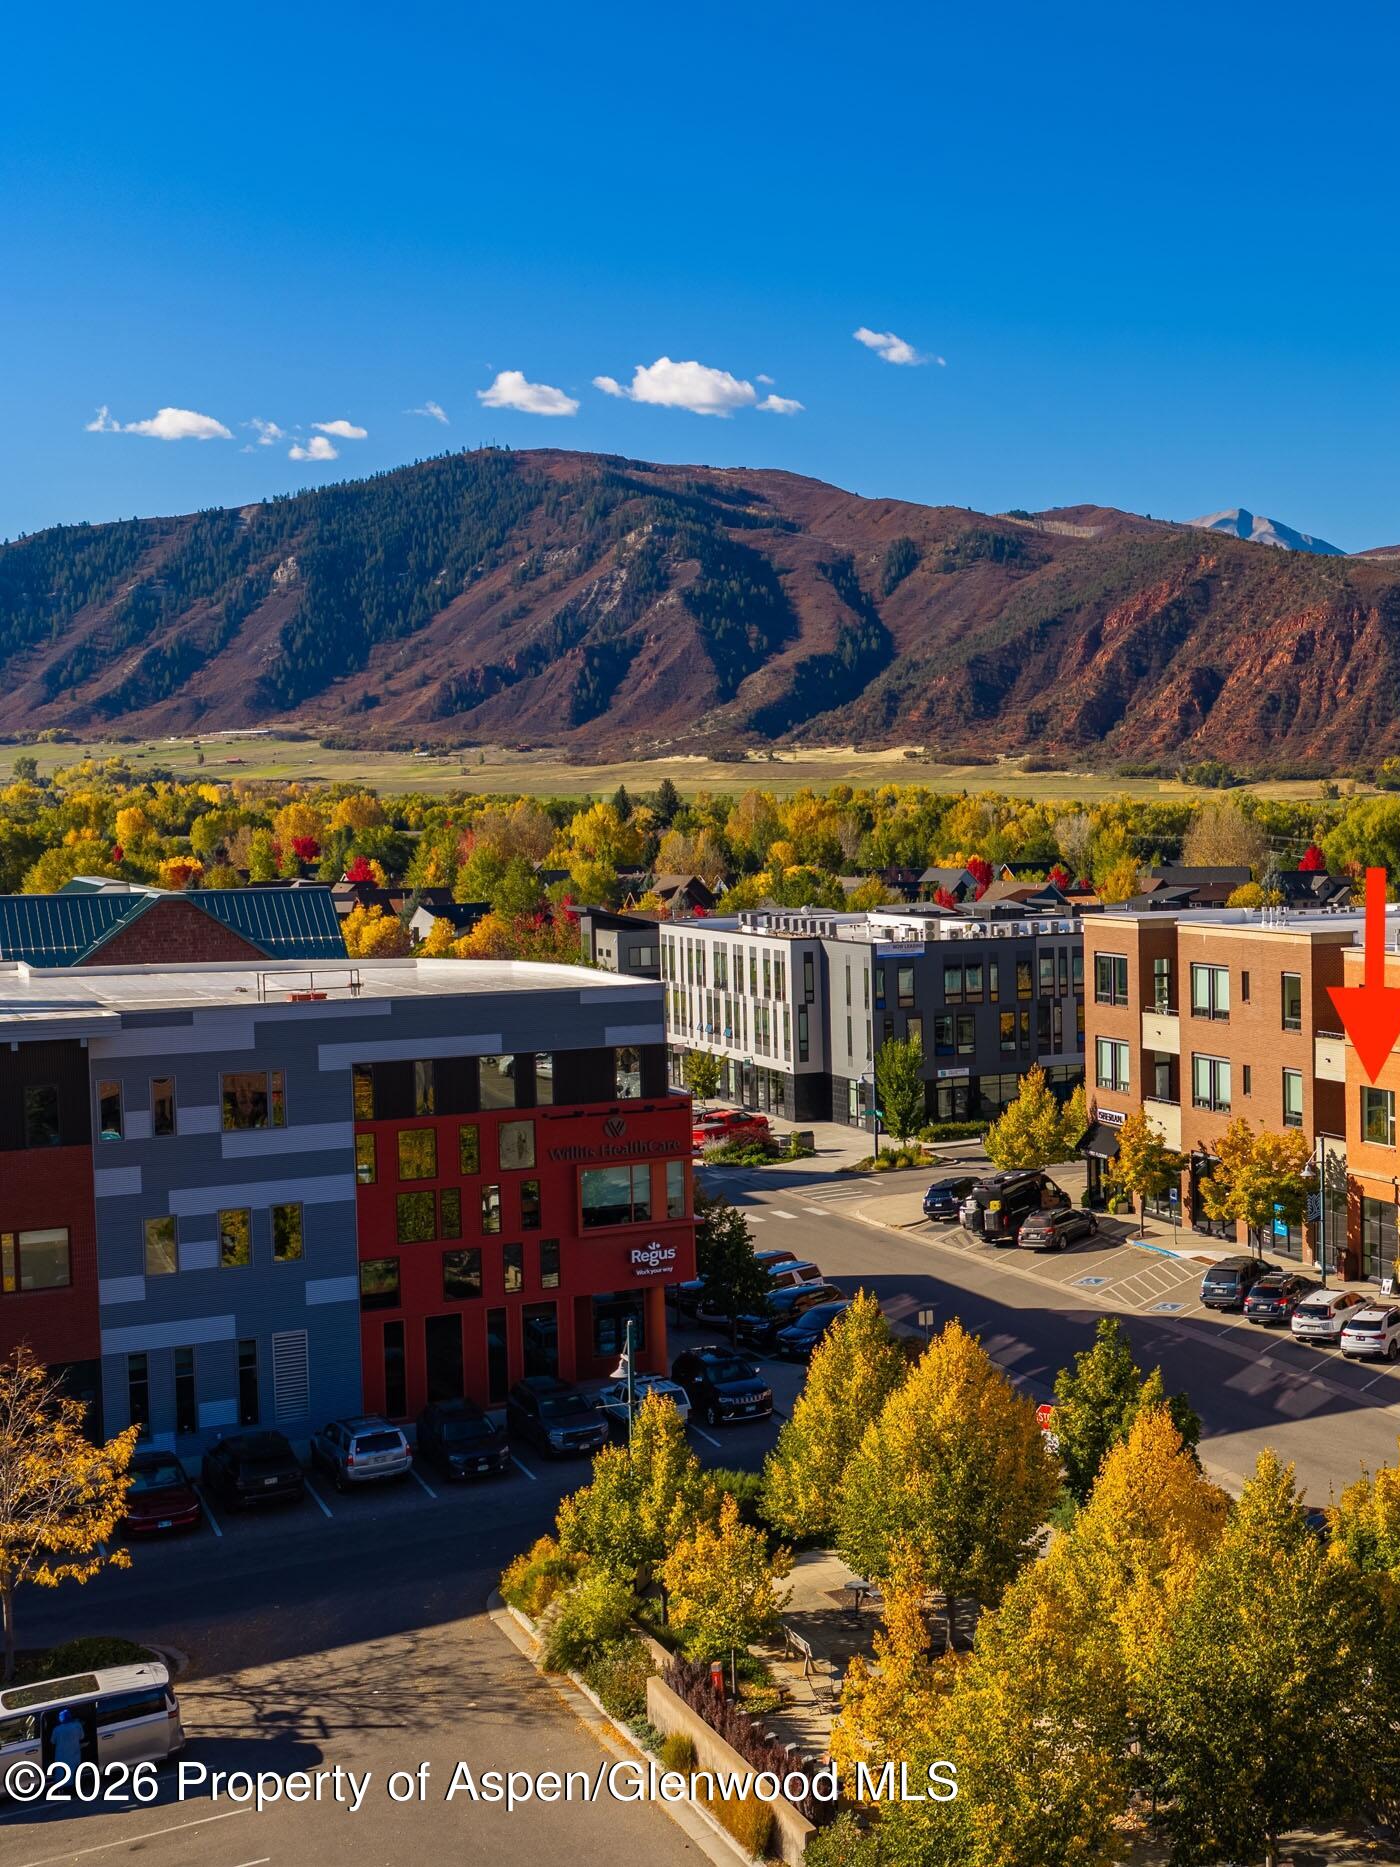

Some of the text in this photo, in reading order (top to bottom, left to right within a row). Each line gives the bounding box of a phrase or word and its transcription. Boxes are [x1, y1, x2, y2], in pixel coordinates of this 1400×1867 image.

[549, 1140, 680, 1160] Willis HealthCare
[631, 1248, 676, 1267] Regus
